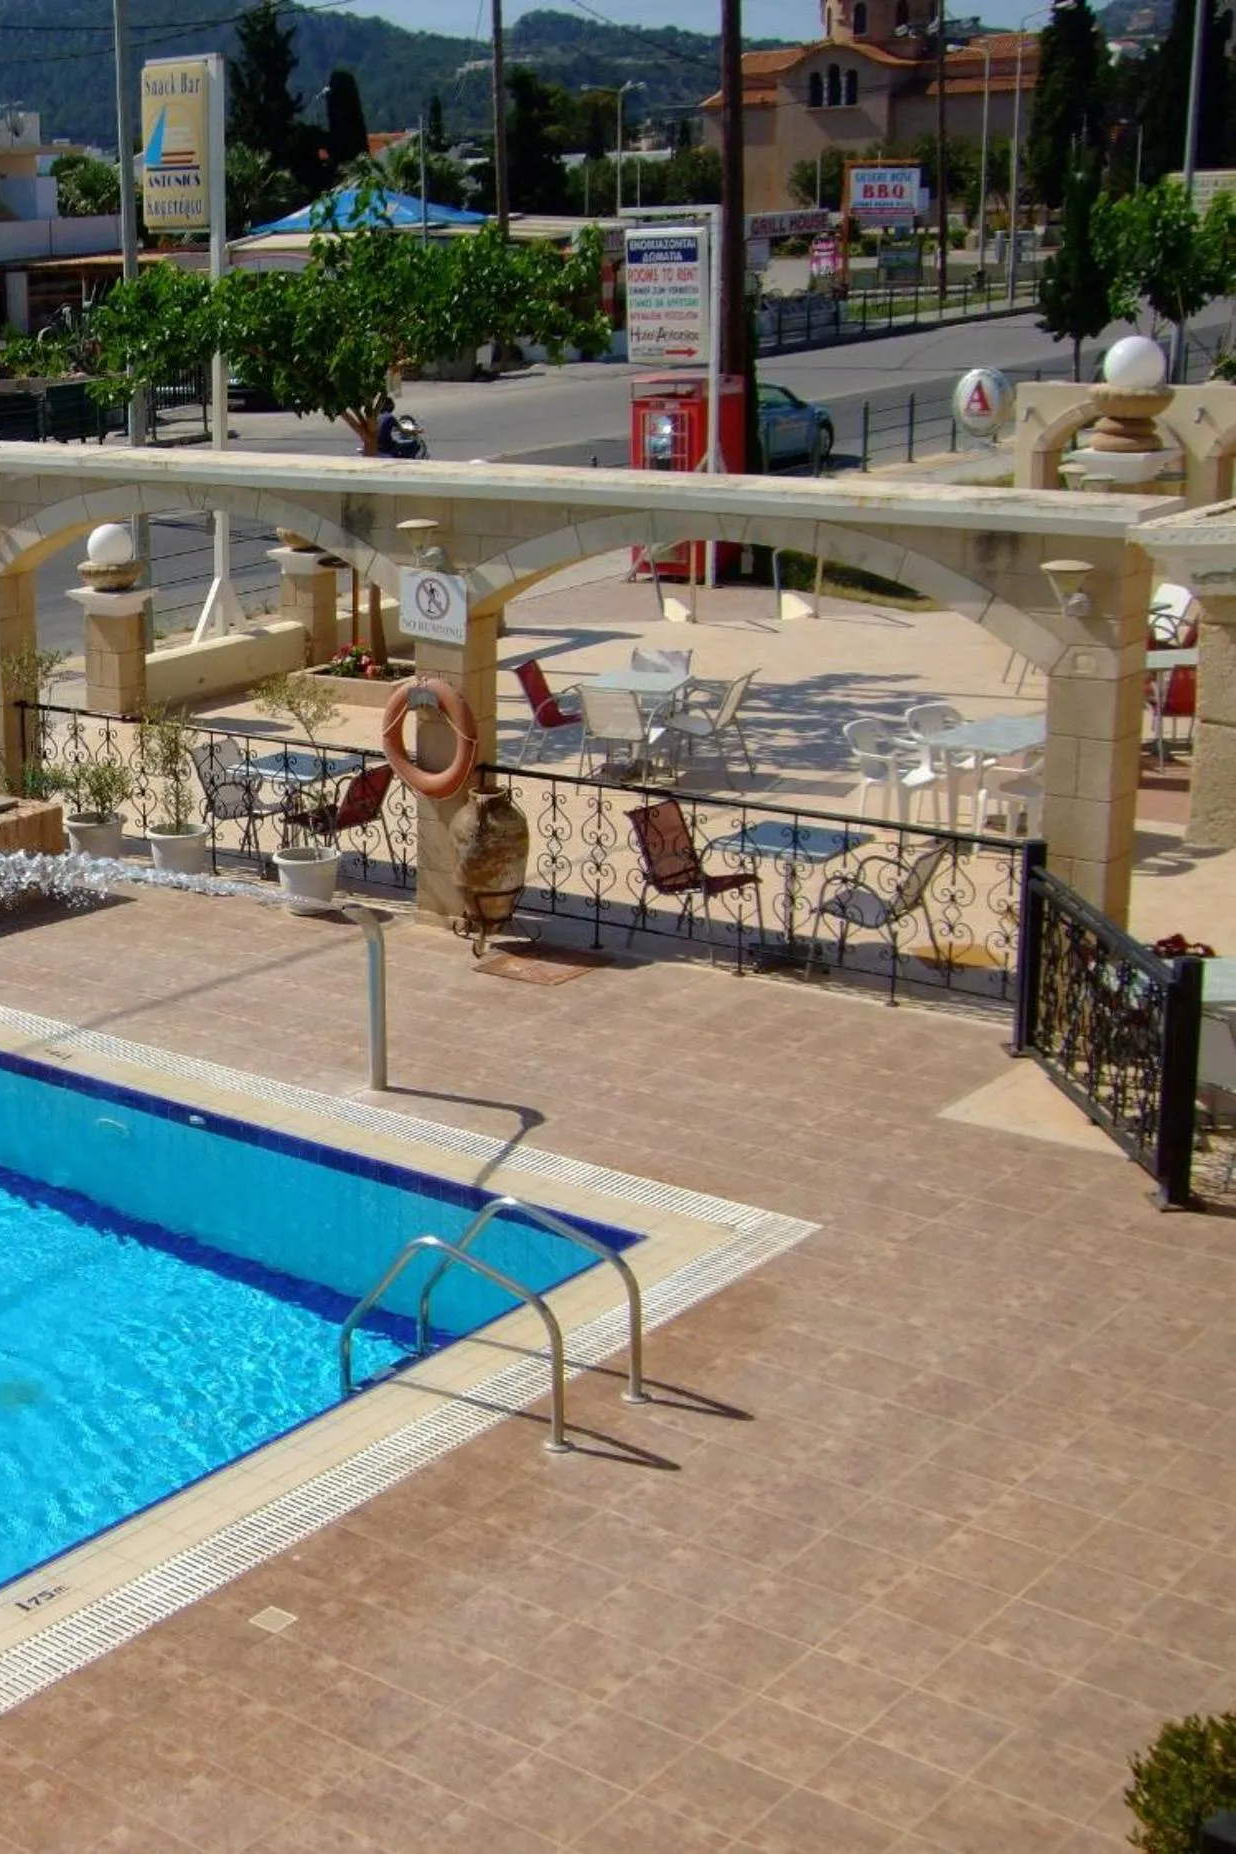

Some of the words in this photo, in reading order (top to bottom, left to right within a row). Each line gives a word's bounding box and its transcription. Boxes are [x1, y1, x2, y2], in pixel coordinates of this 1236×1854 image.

[145, 72, 175, 96] Snack
[181, 72, 200, 93] Bar
[862, 184, 905, 199] BBQ
[628, 267, 659, 283] ROOMS
[662, 267, 673, 282] TO
[676, 266, 698, 281] RENT
[966, 380, 992, 411] A
